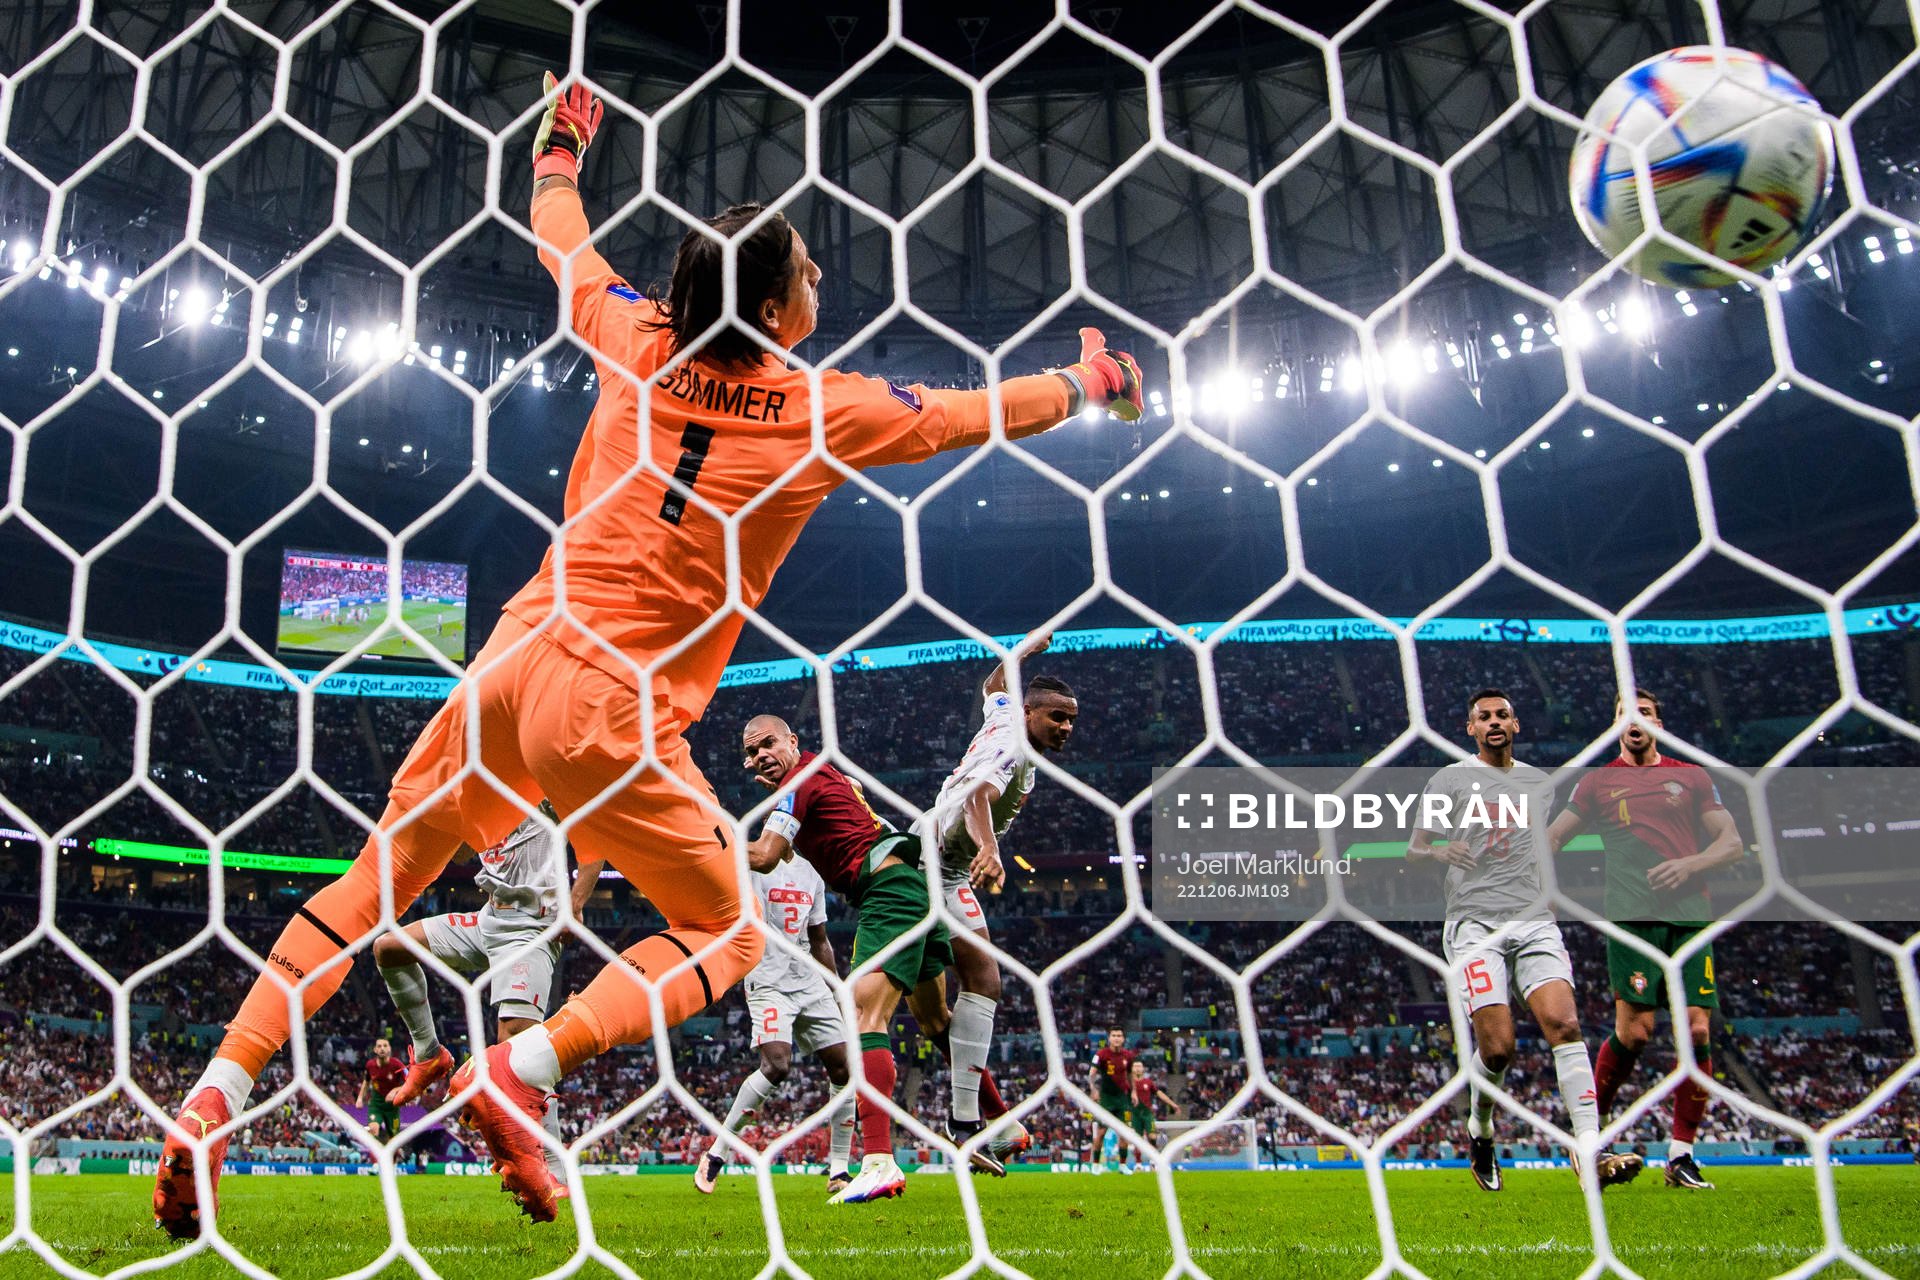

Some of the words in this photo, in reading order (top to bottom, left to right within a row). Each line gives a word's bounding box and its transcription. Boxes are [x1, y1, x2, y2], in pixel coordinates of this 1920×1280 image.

[655, 367, 786, 423] SOMMER
[659, 421, 716, 526] 1
[1239, 627, 1264, 637] FIFA
[1268, 623, 1312, 636] WORLD
[908, 648, 933, 660] FIFA
[935, 643, 978, 656] WORLD
[246, 671, 273, 683] FIFA
[323, 679, 347, 689] CUP
[1619, 799, 1631, 825] 4
[784, 907, 799, 934] 2
[1705, 956, 1715, 984] 4
[763, 1007, 779, 1033] 2
